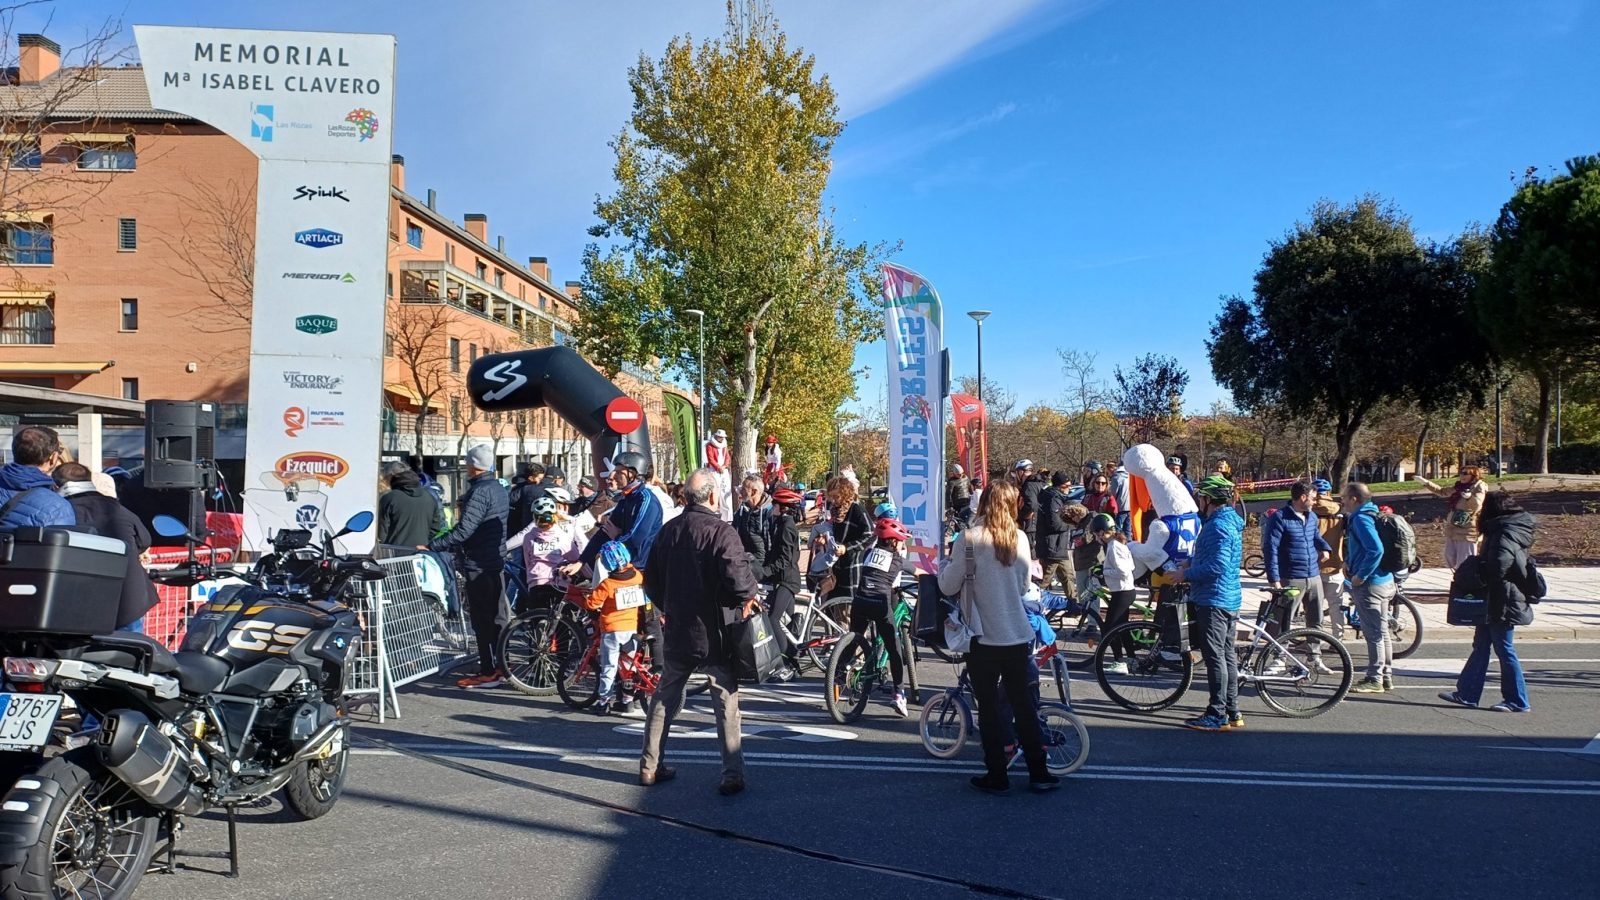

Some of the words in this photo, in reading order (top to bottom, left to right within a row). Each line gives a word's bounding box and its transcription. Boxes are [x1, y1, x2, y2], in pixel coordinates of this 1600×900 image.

[194, 42, 349, 67] MEMORIAL
[163, 72, 191, 88] Mª
[202, 73, 274, 91] ISABEL
[285, 76, 380, 95] CLAVERO
[297, 233, 341, 244] ARTIACH
[282, 272, 340, 280] MERIDA
[296, 318, 337, 328] BAQUE
[283, 374, 331, 383] VICTORY
[282, 458, 339, 476] Ezequiel
[538, 541, 555, 551] 325
[622, 590, 638, 605] 120
[226, 619, 312, 655] GS
[7, 698, 58, 719] 8767
[0, 719, 36, 740] LJS
